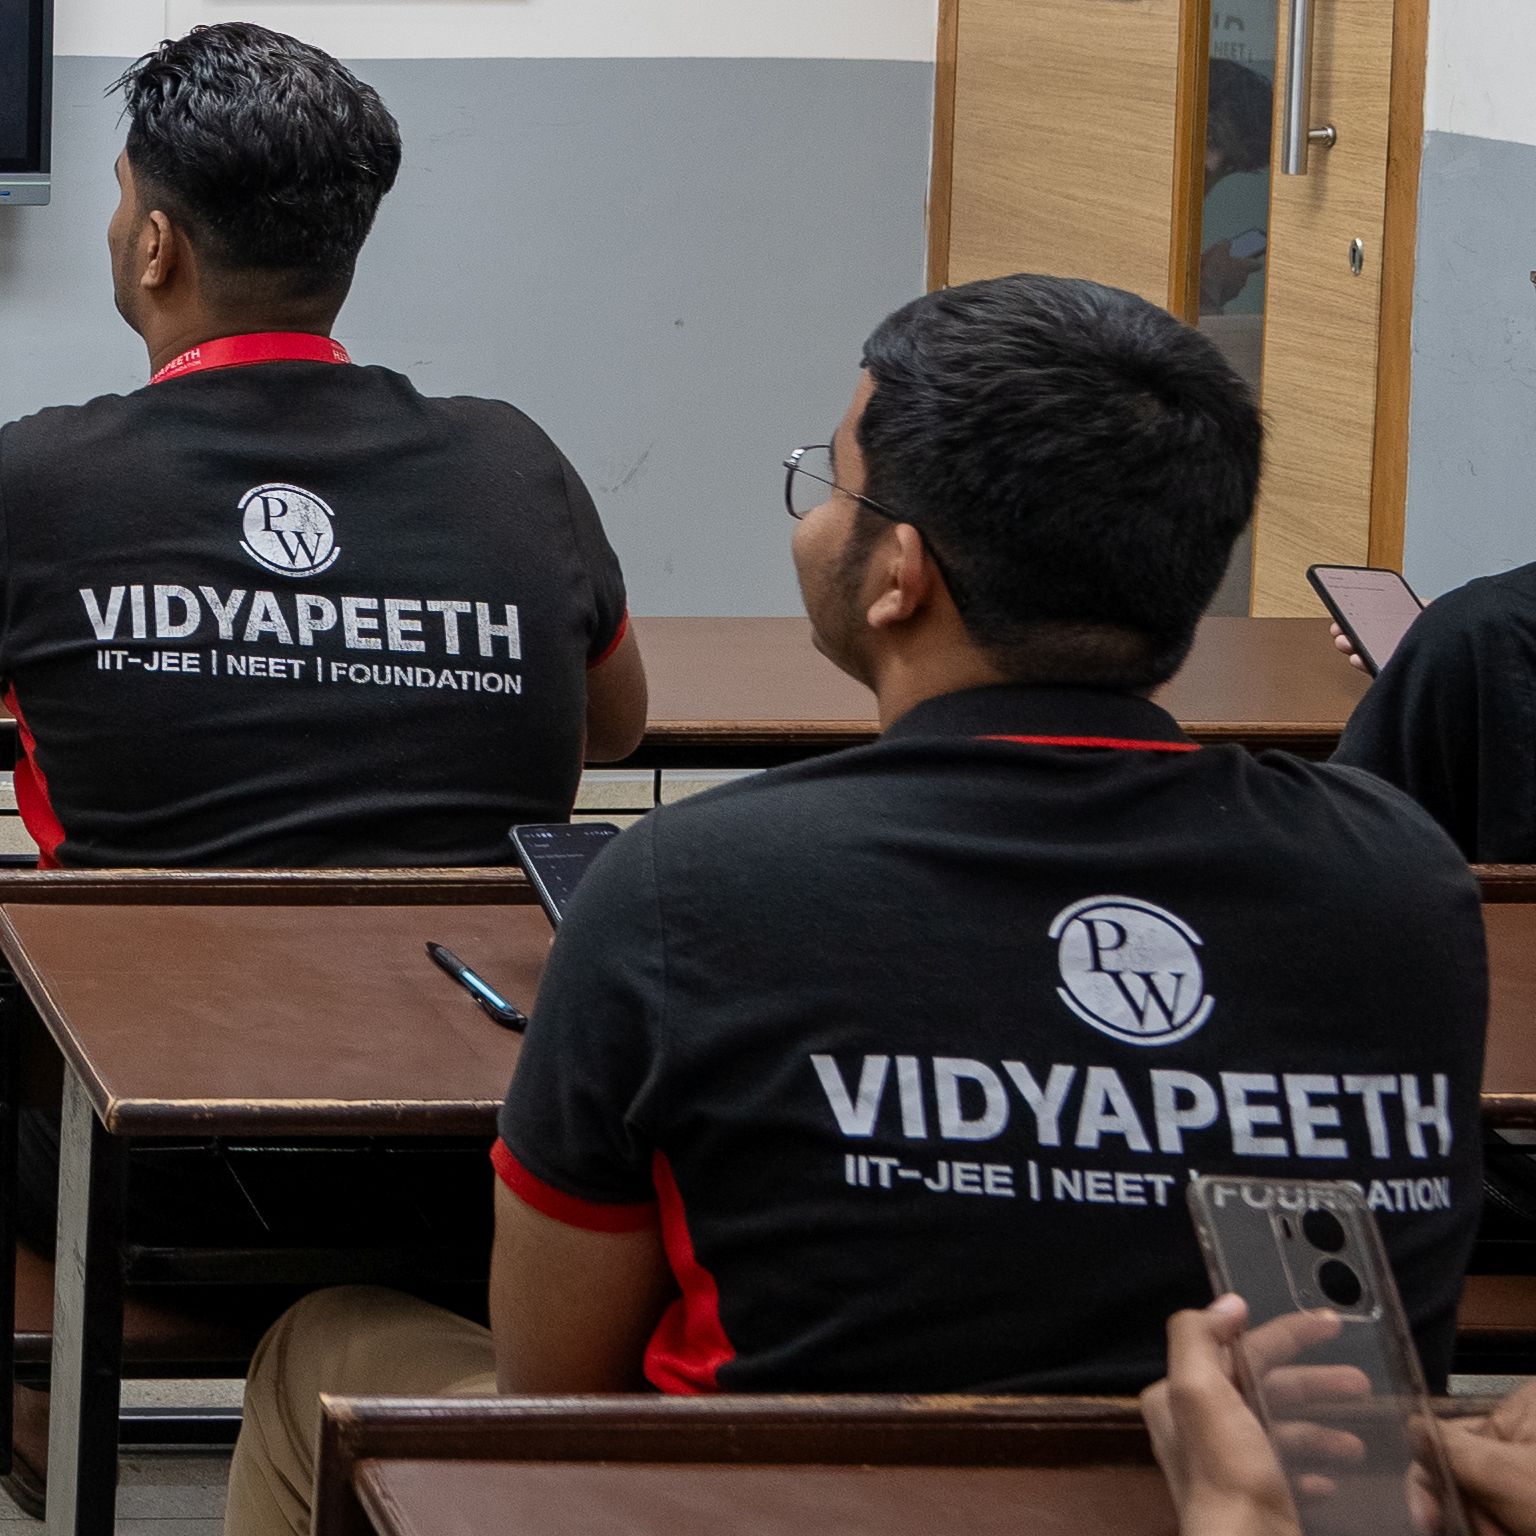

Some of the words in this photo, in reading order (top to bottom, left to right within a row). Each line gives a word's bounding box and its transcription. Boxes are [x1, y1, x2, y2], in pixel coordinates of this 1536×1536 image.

[259, 495, 326, 566] PW
[79, 585, 522, 660] VIDYAPEETH
[97, 649, 201, 674] IIT-JEE
[228, 656, 305, 680] NEET
[331, 662, 522, 695] FOUNDATION
[1077, 918, 1186, 1032] PW
[809, 1055, 1452, 1158] VIDYAPEETH
[845, 1154, 1015, 1199] IIT-JEE
[1054, 1169, 1174, 1206] NEET
